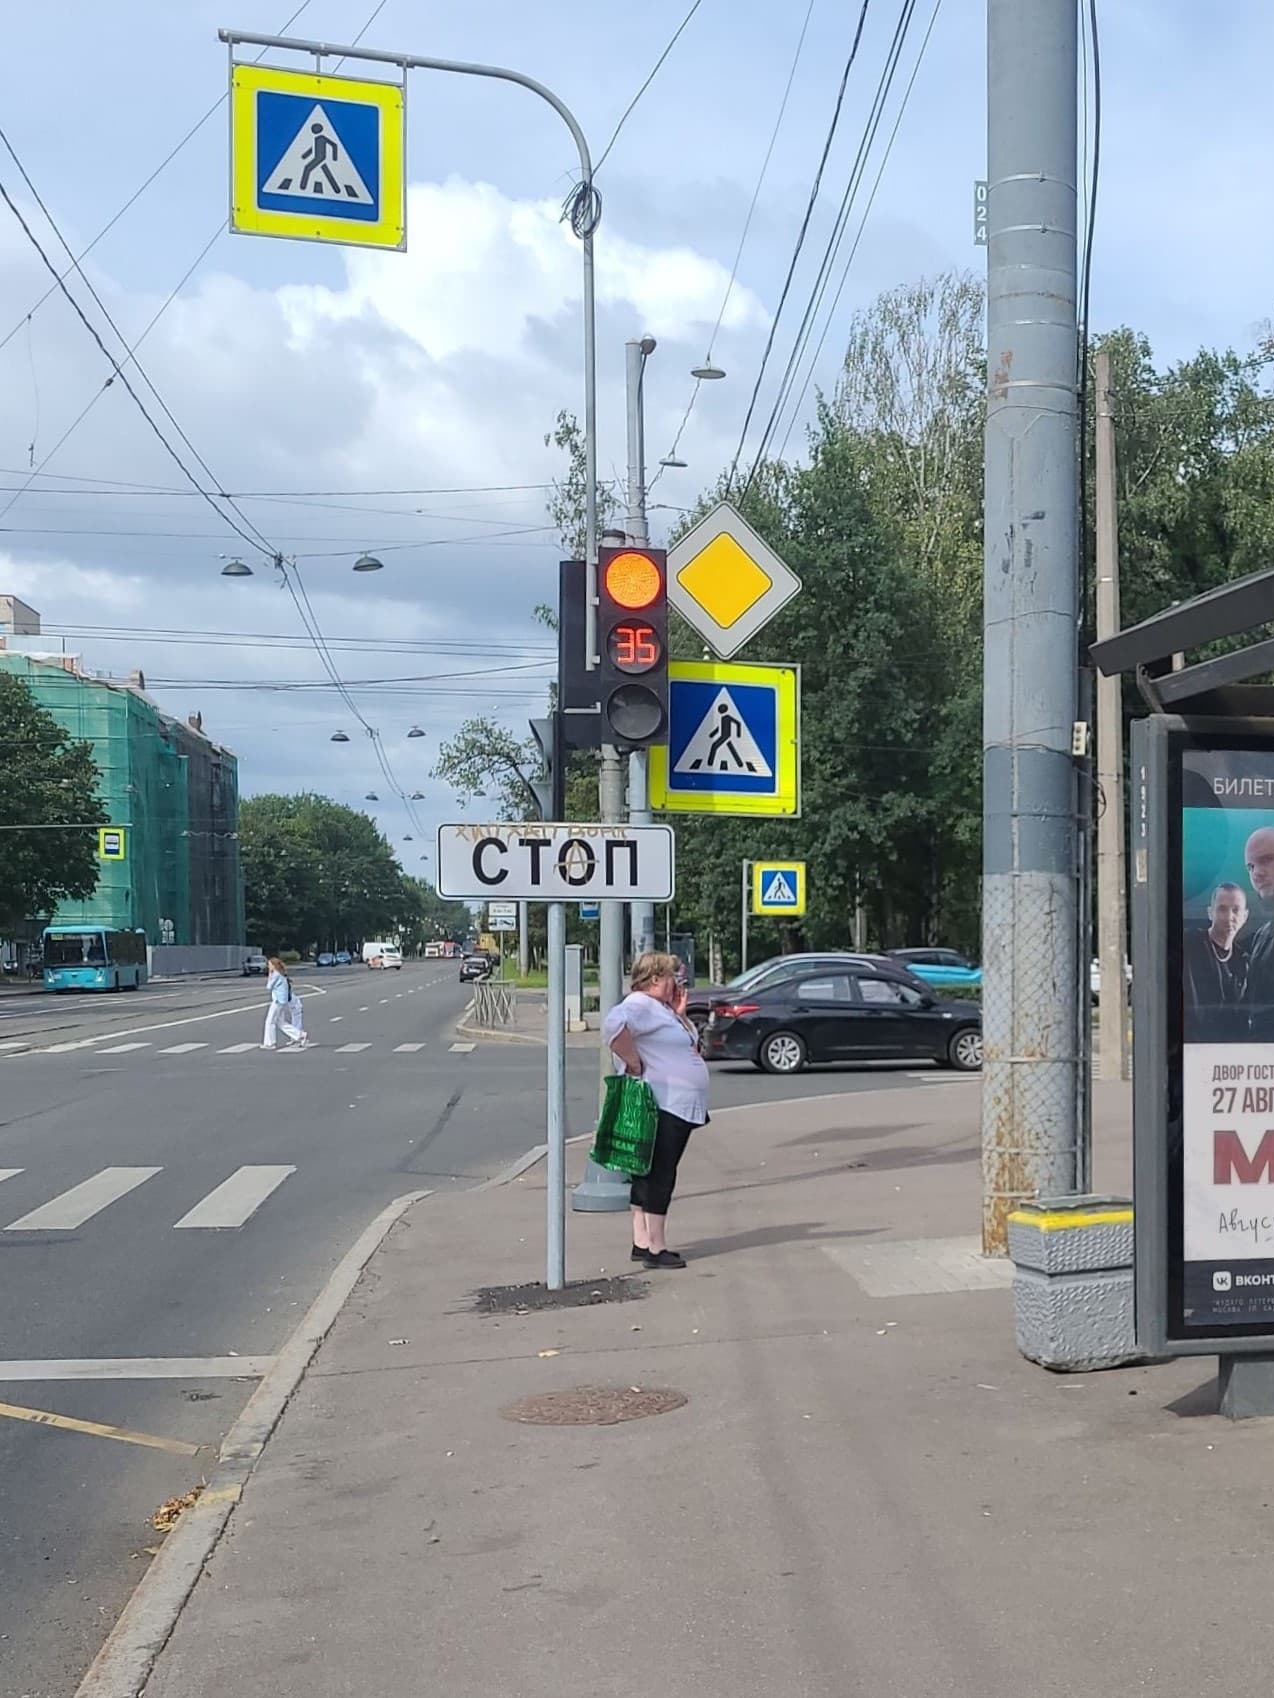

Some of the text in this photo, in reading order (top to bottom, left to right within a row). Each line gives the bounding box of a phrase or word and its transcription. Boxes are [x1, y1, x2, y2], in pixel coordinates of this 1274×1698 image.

[616, 627, 656, 664] 35
[472, 838, 638, 886] СТОП
[1212, 1065, 1244, 1082] ДВОР
[1212, 1087, 1236, 1114] 27
